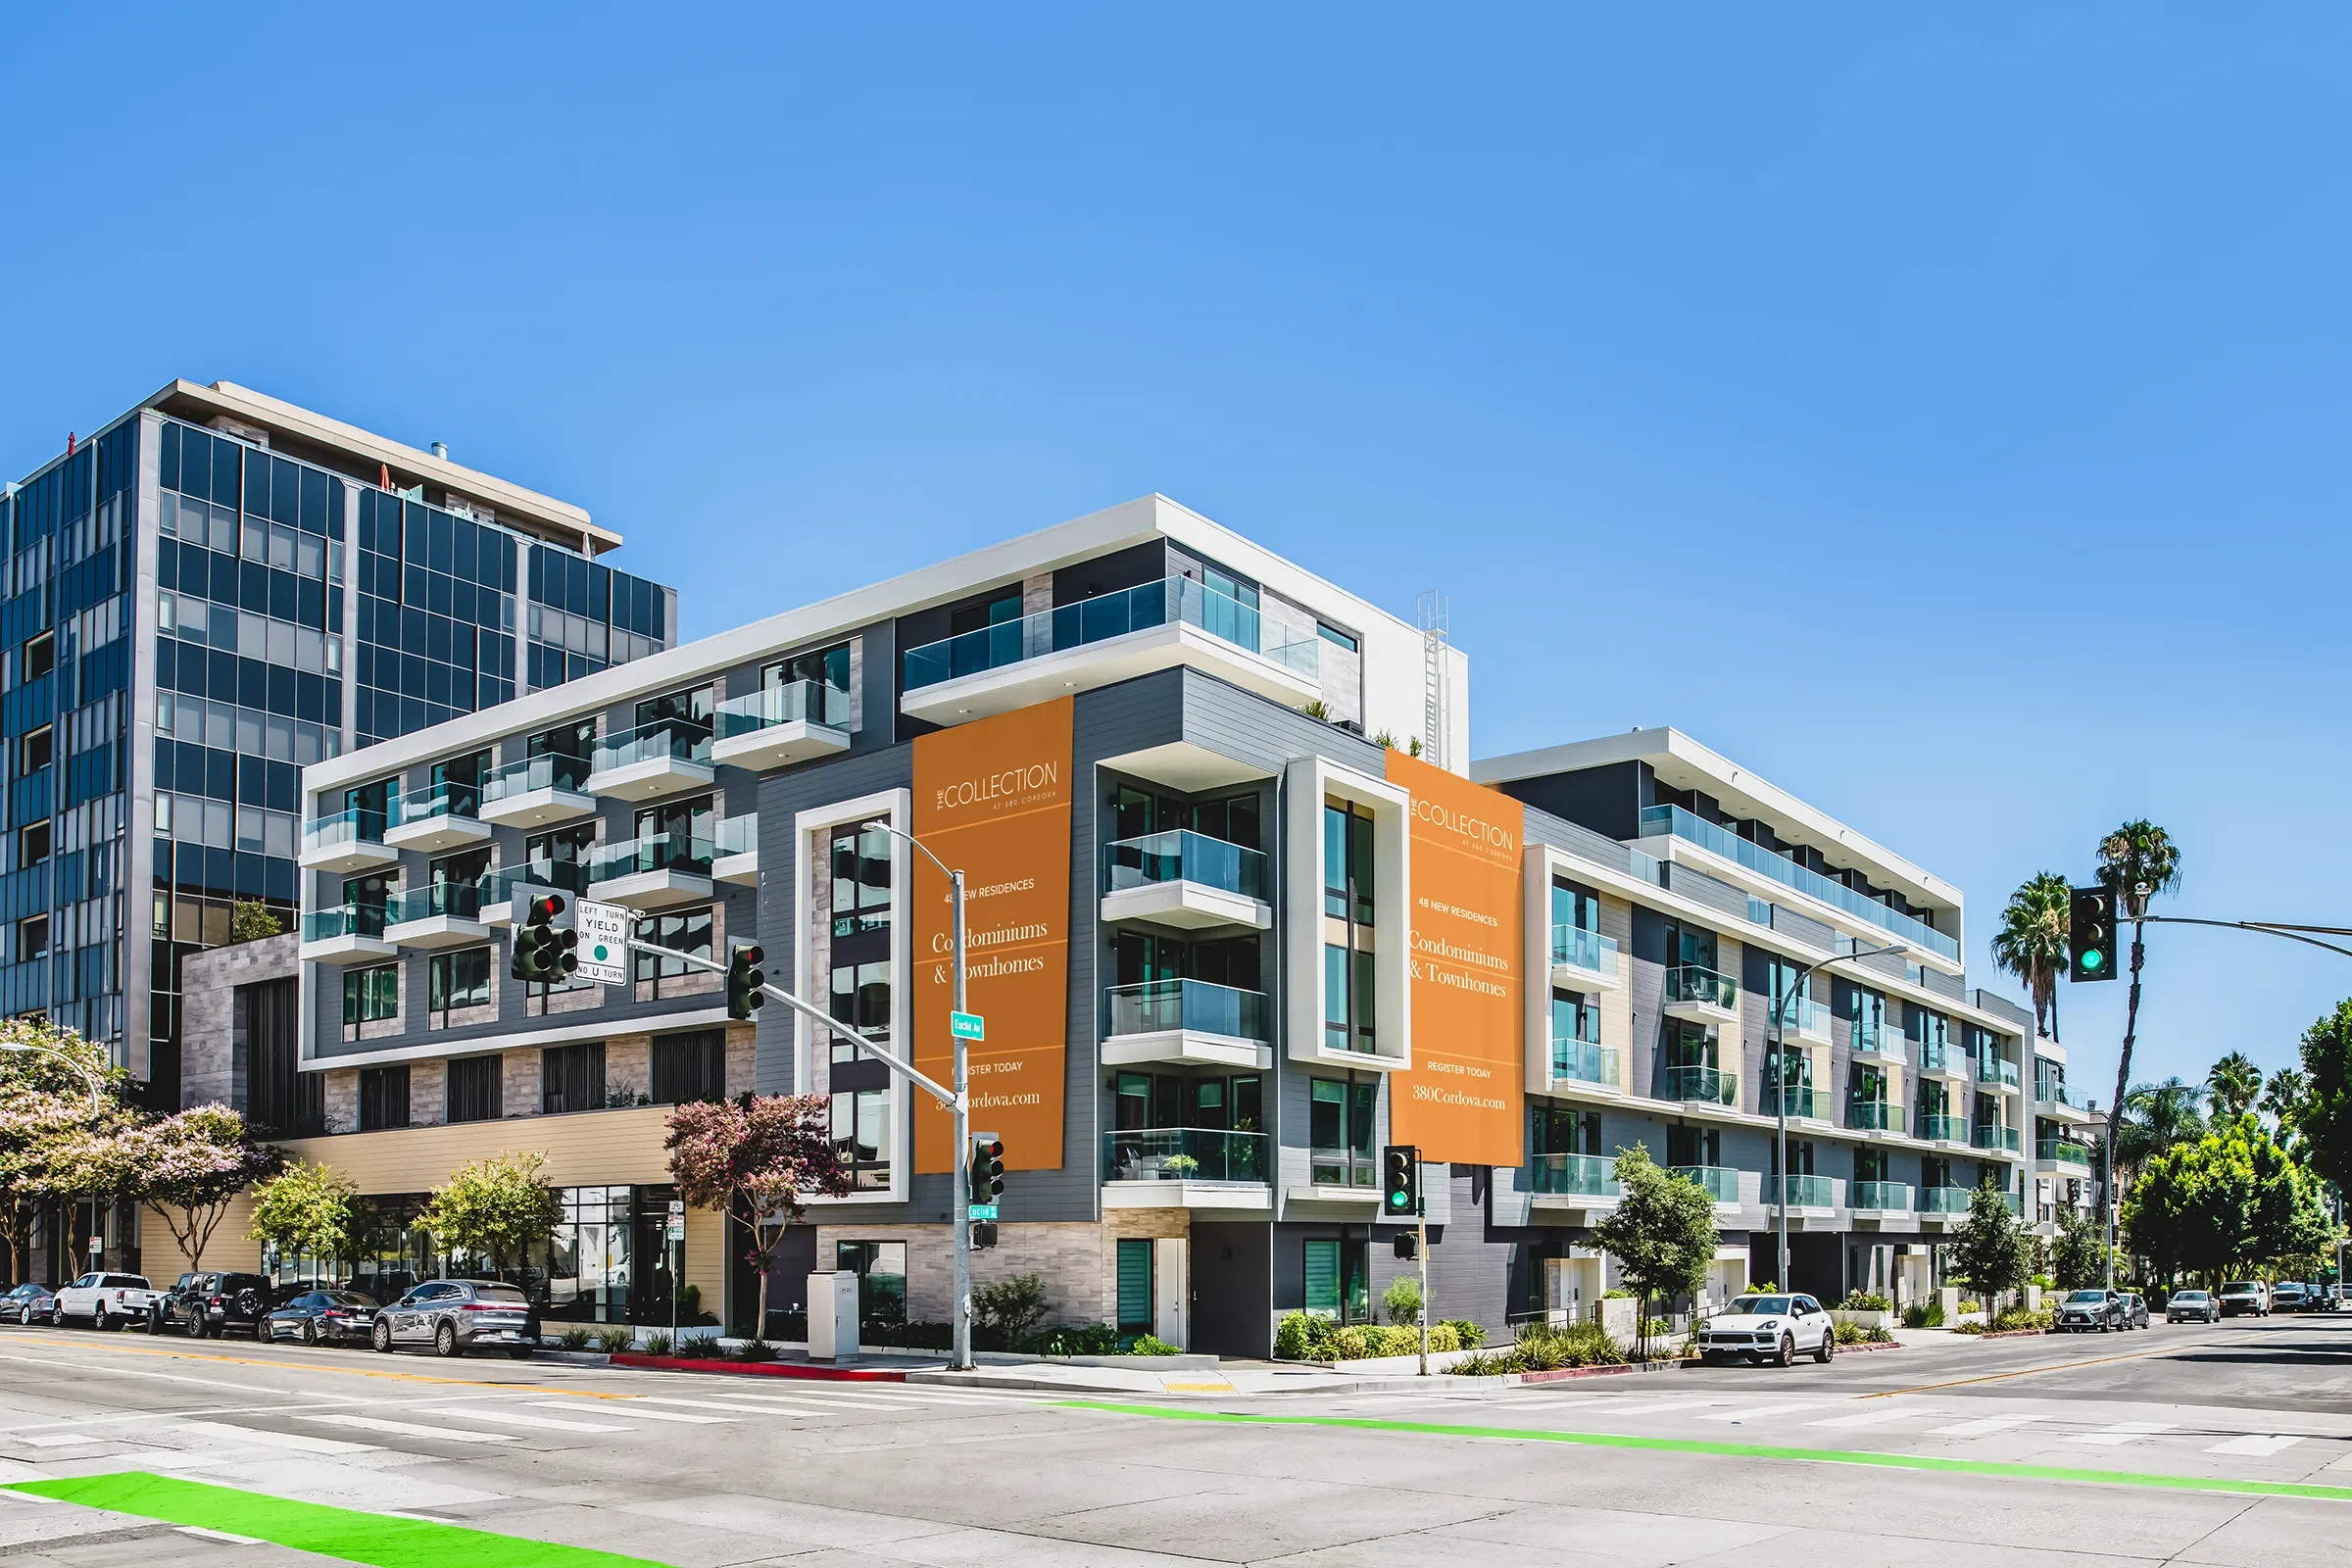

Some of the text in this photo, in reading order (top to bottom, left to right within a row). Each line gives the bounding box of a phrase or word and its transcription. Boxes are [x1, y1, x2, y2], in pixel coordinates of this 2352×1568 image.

[945, 760, 1056, 808] COLLECTION
[1021, 791, 1056, 804] CORDOVA
[1417, 800, 1513, 851] COLLECTION
[963, 889, 977, 901] EW
[979, 878, 1035, 898] RESIDENCES
[579, 906, 624, 920] LEFT TURN
[1418, 898, 1497, 927] 48 NEW RESIDENCES
[585, 918, 618, 932] YIELD
[598, 934, 623, 945] GREEN
[932, 921, 1048, 953] Codominiums
[1409, 930, 1508, 970] Condominiums
[592, 966, 599, 976] U
[604, 969, 622, 979] TURN
[934, 956, 1044, 984] & ownhomes
[1410, 959, 1506, 997] & Townhomes
[993, 1061, 1023, 1073] TODAY
[1427, 1060, 1492, 1078] REGISTER TODAY
[935, 1092, 1040, 1110] 3ordova.com
[1412, 1084, 1505, 1109] 380Cordova.com
[969, 1206, 989, 1215] Euclid
